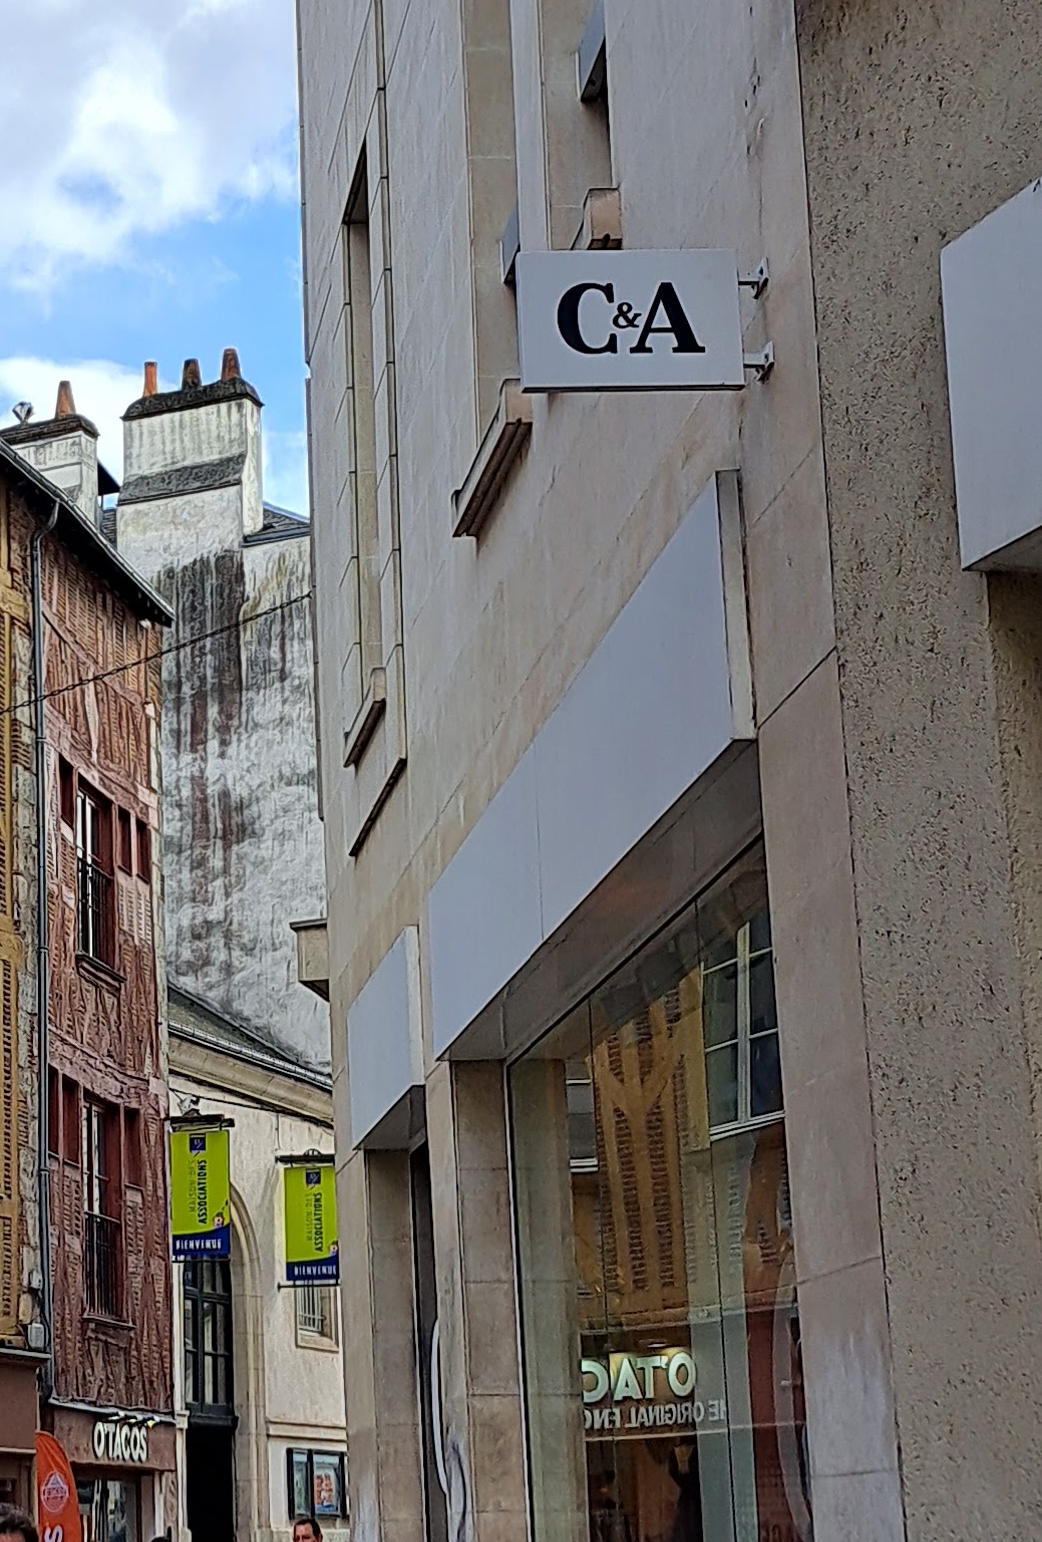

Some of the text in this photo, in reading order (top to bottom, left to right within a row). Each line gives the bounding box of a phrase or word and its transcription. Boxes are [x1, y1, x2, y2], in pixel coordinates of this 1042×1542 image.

[556, 281, 706, 355] C&A
[197, 1159, 208, 1225] ASSOCIATIONS
[314, 1191, 324, 1253] ASSOCIATIONS
[175, 1237, 222, 1250] BIENVENUE
[93, 1421, 148, 1462] O'TACOS
